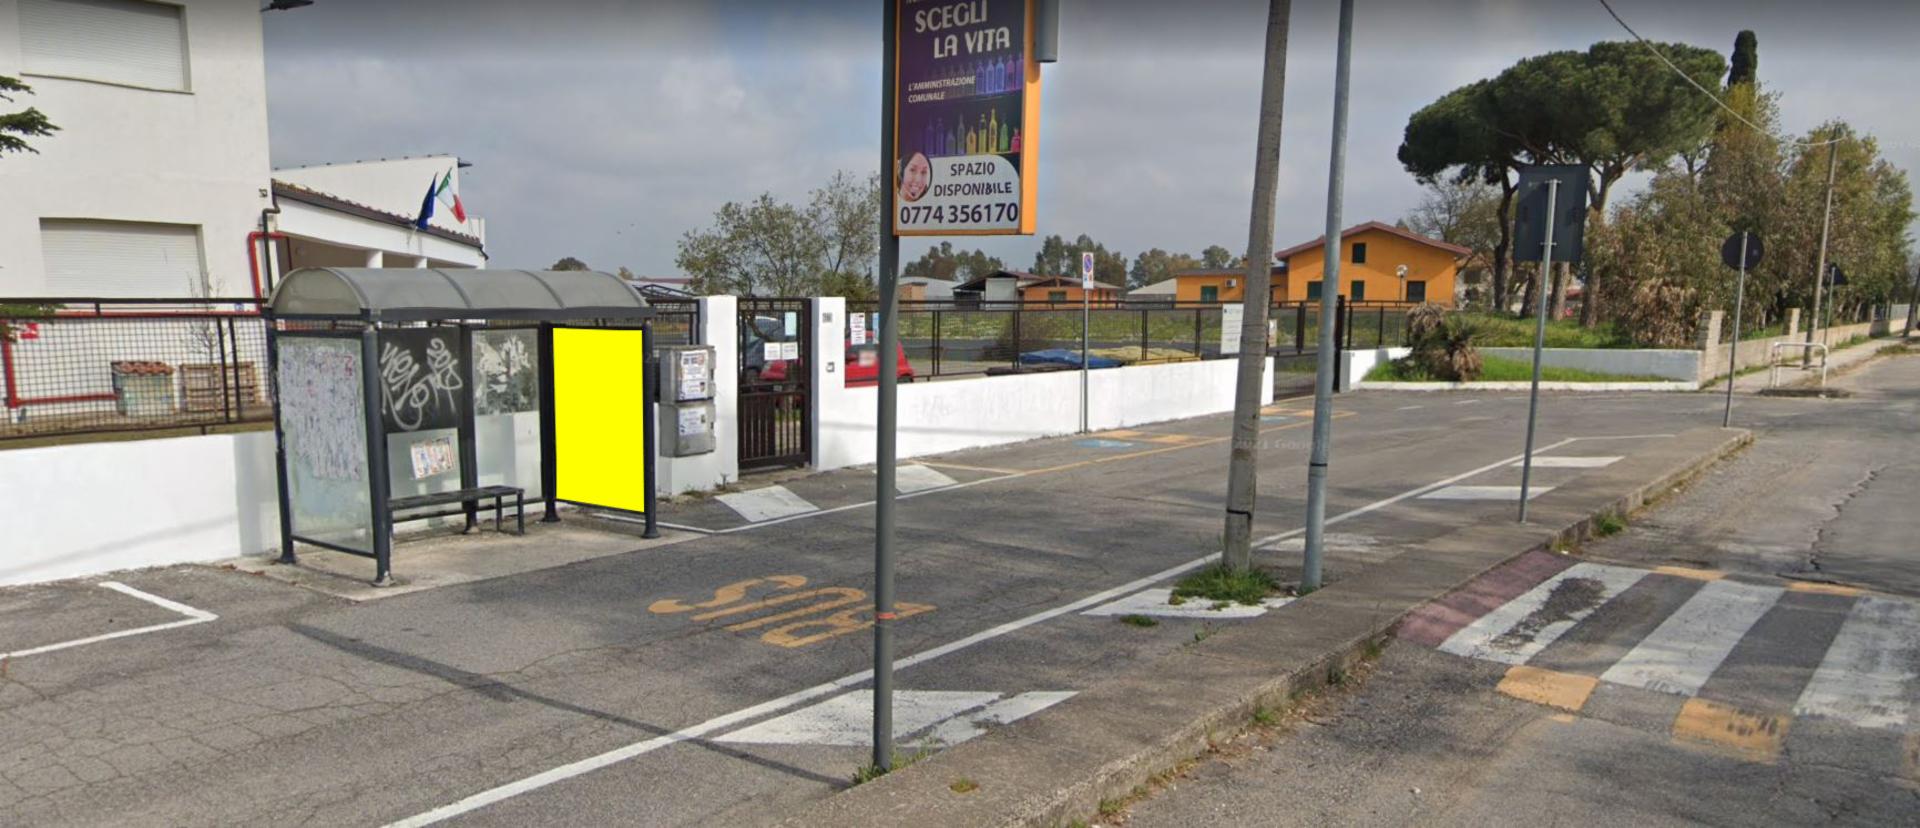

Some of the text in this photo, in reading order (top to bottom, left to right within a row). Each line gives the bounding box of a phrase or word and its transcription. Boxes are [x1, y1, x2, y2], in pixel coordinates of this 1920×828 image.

[915, 0, 988, 33] SCEGLI
[933, 27, 1010, 59] LA VITA
[909, 75, 976, 91] L'AMMINISTRAZIONE
[908, 91, 945, 103] COMUNALE
[950, 161, 995, 176] SPAZIO
[933, 181, 1012, 197] DISPONIBILE
[900, 202, 1018, 224] 0774 356170
[648, 575, 937, 648] BUS
